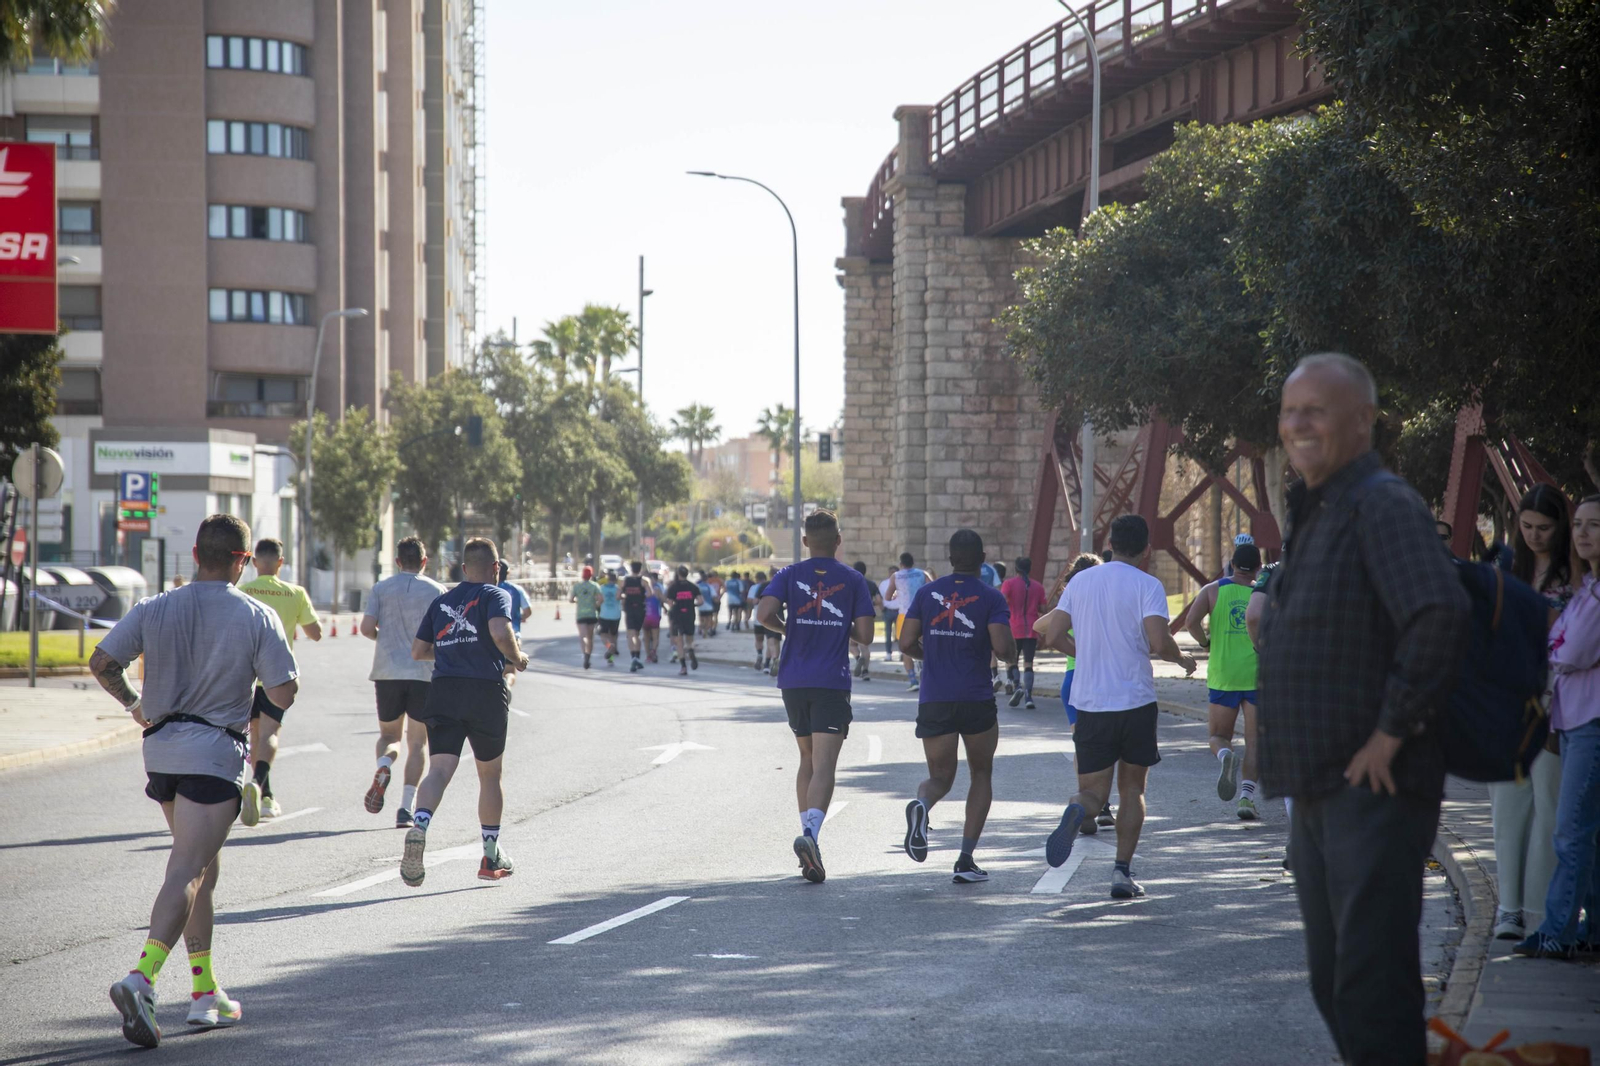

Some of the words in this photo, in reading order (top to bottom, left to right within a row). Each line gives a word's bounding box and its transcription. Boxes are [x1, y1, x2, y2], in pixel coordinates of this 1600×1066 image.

[98, 446, 174, 459] Novovisión
[126, 473, 145, 500] P
[76, 596, 98, 607] 220
